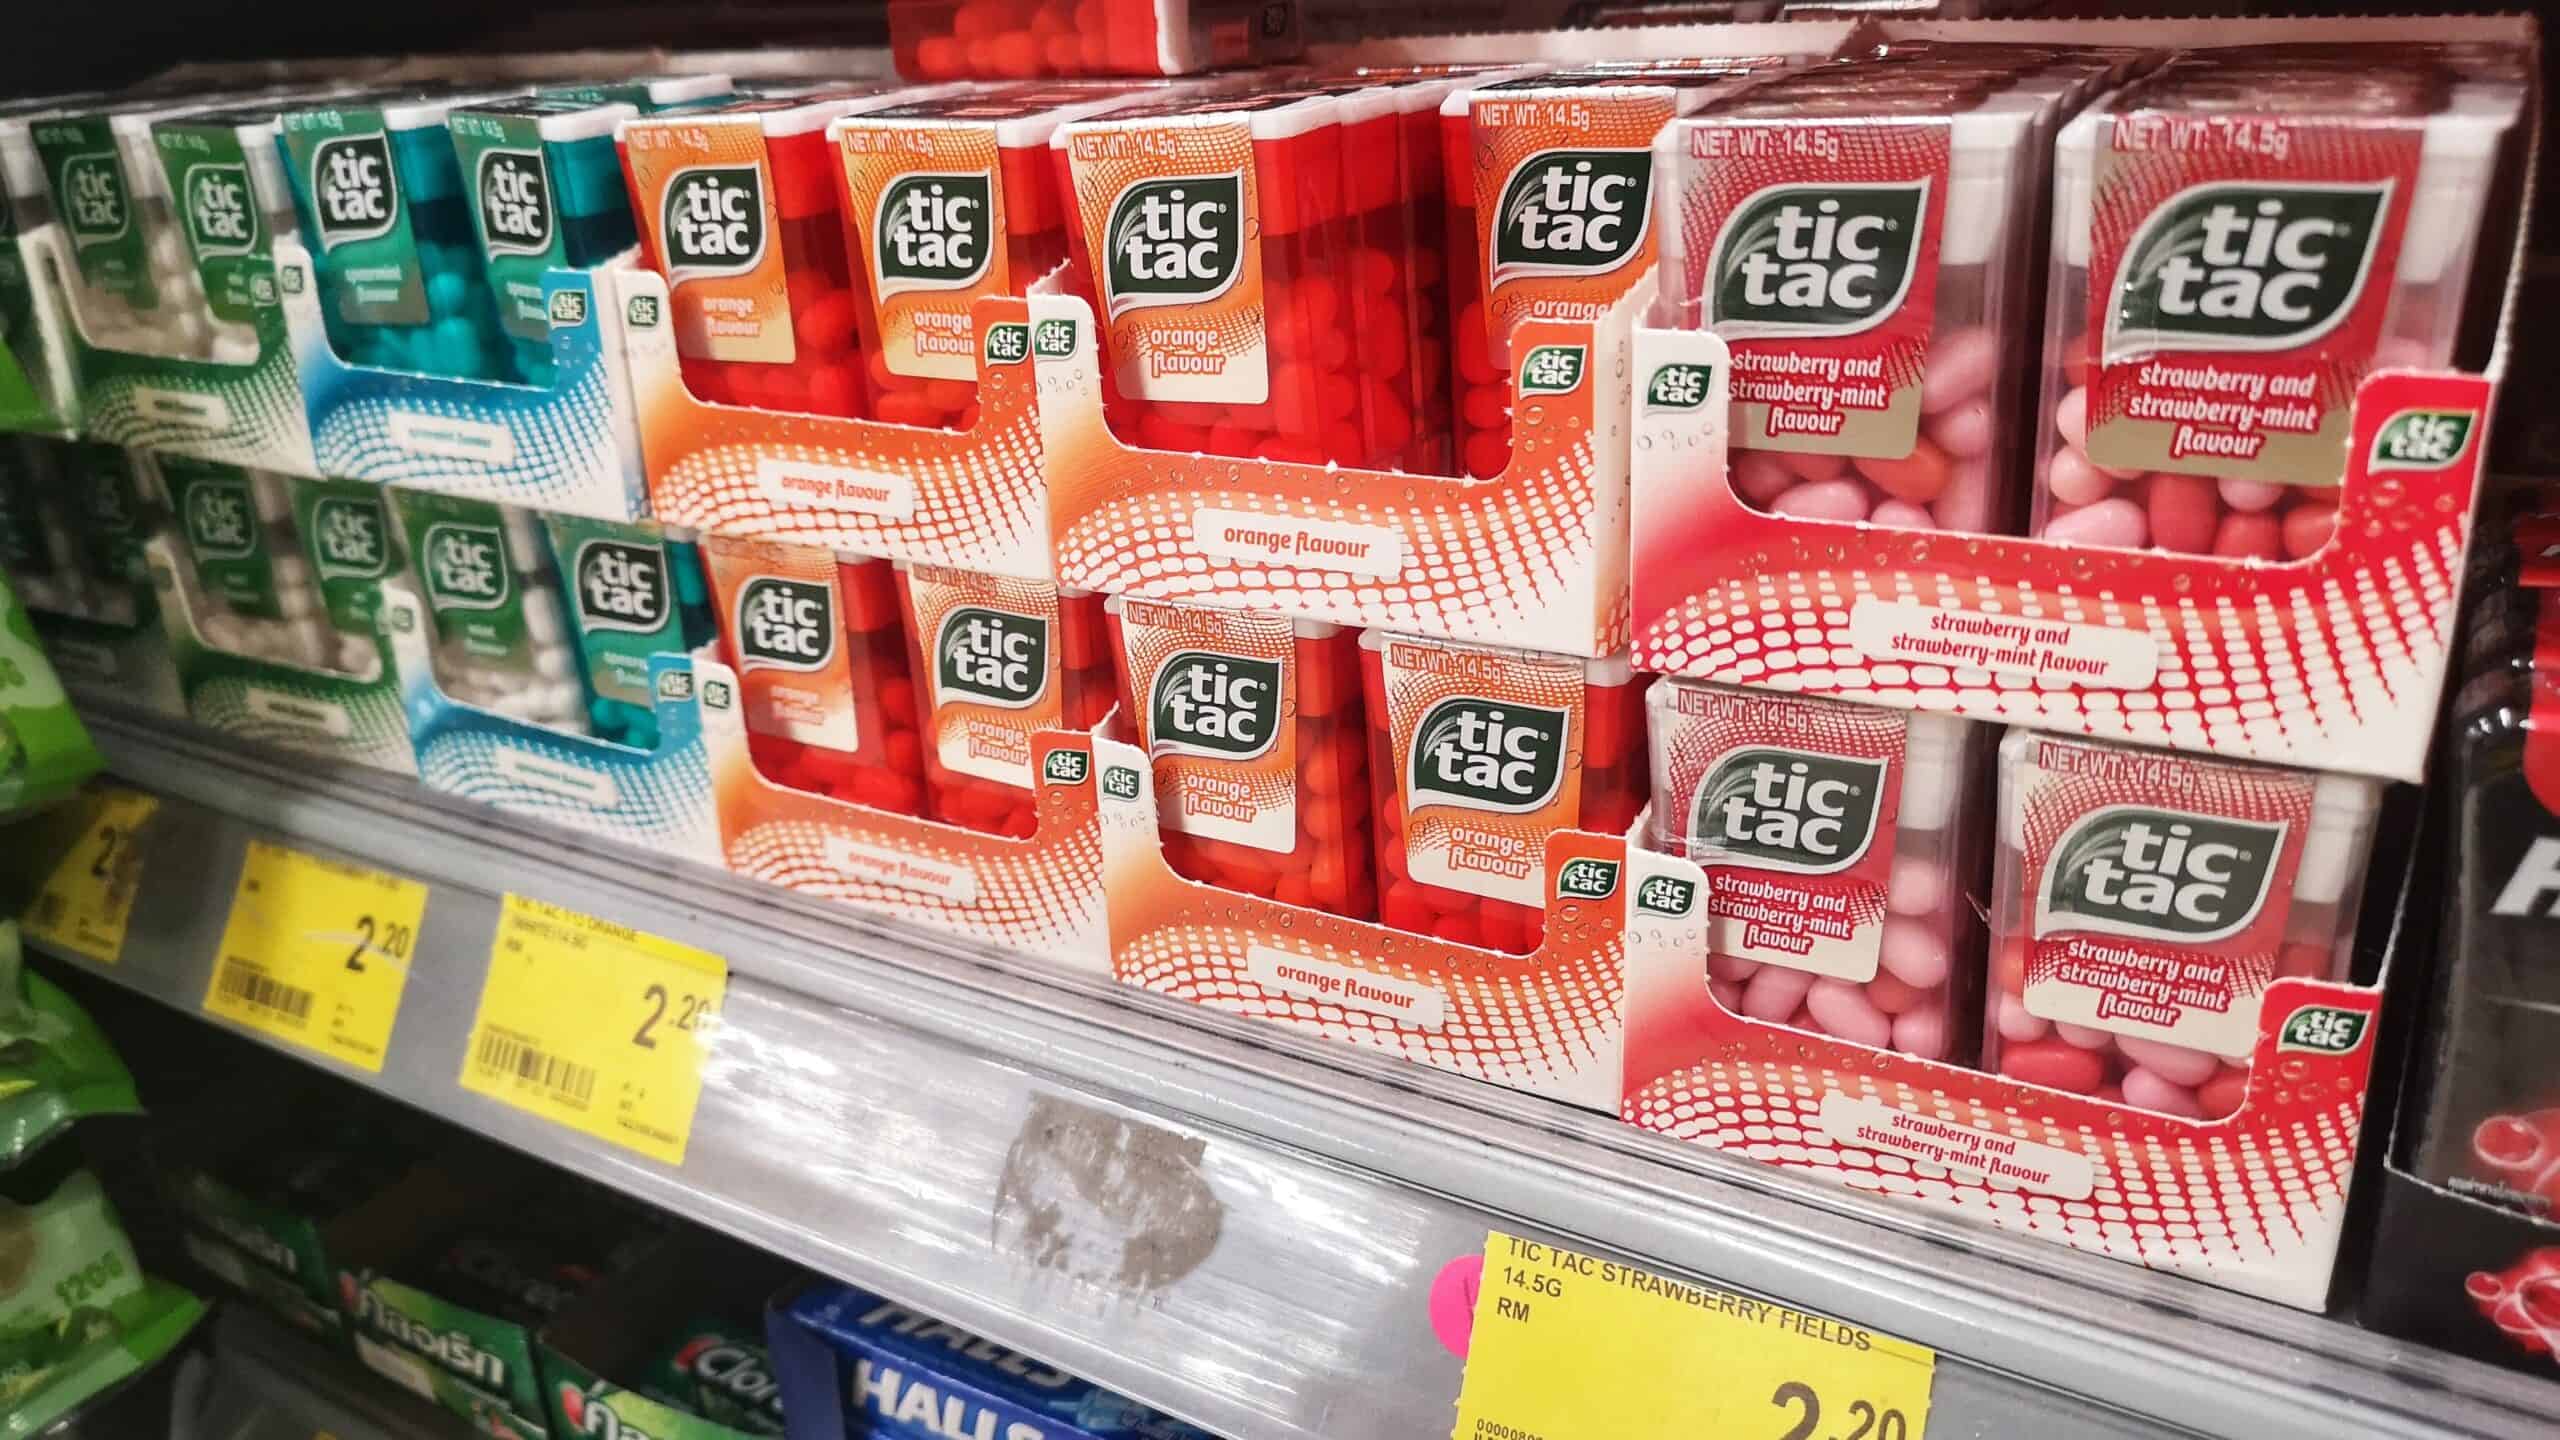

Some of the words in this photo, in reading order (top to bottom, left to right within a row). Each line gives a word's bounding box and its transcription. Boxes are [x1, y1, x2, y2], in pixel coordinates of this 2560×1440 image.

[1479, 103, 1510, 126] NET
[1546, 106, 1590, 132] 14.5g
[847, 131, 873, 153] NET
[900, 132, 935, 158] 14.5g
[1075, 135, 1104, 160] NET
[1135, 138, 1176, 160] 14.5g
[1694, 128, 1733, 156] NET
[1783, 129, 1839, 162] 14.5g
[2114, 121, 2159, 150] NET
[2224, 124, 2289, 158] 14.5g
[330, 147, 381, 188] tic
[492, 160, 539, 203] tic
[199, 174, 243, 210] tic
[326, 187, 385, 222] tac
[686, 176, 747, 222] tic
[1543, 161, 1626, 212] tic
[197, 208, 249, 239] tac
[489, 198, 543, 237] tac
[906, 185, 973, 233] tic
[1142, 189, 1219, 240] tic
[677, 218, 751, 257] tac
[1519, 206, 1621, 252] tac
[1774, 199, 1884, 261] tic
[2201, 200, 2335, 268] tic
[896, 228, 974, 268] tac
[1126, 234, 1219, 280] tac
[1742, 252, 1878, 309] tac
[2158, 255, 2321, 322] tac
[998, 327, 1024, 343] tic
[1040, 337, 1070, 352] tac
[1046, 322, 1072, 338] tic
[1150, 326, 1218, 351] orange
[992, 342, 1022, 356] tac
[1154, 351, 1226, 376] flavour
[1540, 350, 1577, 369] tic
[1734, 350, 1839, 382] strawberry
[1844, 355, 1882, 378] and
[1531, 365, 1573, 385] tac
[1664, 366, 1702, 388] tic
[2139, 364, 2262, 400] strawberry
[2269, 373, 2316, 398] and
[1654, 384, 1700, 404] tac
[1730, 380, 1886, 410] strawberry-mint
[2130, 393, 2317, 430] strawberry-mint
[1770, 407, 1841, 433] flavour
[2407, 416, 2455, 444] tic
[2175, 427, 2260, 457] flavour
[2390, 435, 2449, 461] tac
[1223, 525, 1292, 553] orange
[1295, 529, 1371, 559] flavour
[600, 551, 653, 590] tic
[590, 582, 655, 618] tac
[762, 587, 819, 626] tic
[753, 619, 820, 657] tac
[1128, 602, 1154, 624] NET
[1185, 611, 1222, 638] 14.5g
[1931, 613, 2030, 646] strawberry
[2035, 627, 2071, 646] and
[967, 618, 1029, 663] tic
[1892, 633, 2036, 667] strawberry-mint
[2039, 646, 2109, 676] flavour
[954, 648, 1029, 693] tac
[1393, 645, 1422, 668] NET
[1459, 656, 1501, 685] 14.5g
[1192, 663, 1260, 711] tic
[1171, 697, 1257, 743] tac
[1678, 692, 1717, 715] NET
[1756, 701, 1808, 733] 14.5g
[969, 720, 1024, 745] orange
[1459, 711, 1540, 760] tic
[969, 737, 1028, 765] flavour
[1056, 752, 1081, 767] tic
[1435, 742, 1536, 795] tac
[1052, 763, 1081, 778] tac
[1108, 779, 1134, 796] tac
[1113, 769, 1136, 785] tic
[1187, 772, 1251, 801] orange
[2040, 746, 2084, 772] NET
[2132, 761, 2195, 794] 14.5g
[1751, 761, 1851, 817] tic
[1186, 793, 1257, 822] flavour
[1451, 826, 1526, 857] orange
[1723, 796, 1842, 856] tac
[1449, 847, 1531, 878] flavour
[2121, 822, 2239, 883] tic
[1568, 877, 1605, 892] tac
[1577, 863, 1609, 880] tic
[1654, 880, 1686, 899] tic
[2083, 857, 2227, 922] tac
[1645, 893, 1684, 912] tac
[1715, 875, 1810, 908] strawberry
[1813, 891, 1846, 912] and
[1709, 897, 1852, 938] strawberry-mint
[345, 915, 410, 974] 2.20
[1748, 924, 1812, 953] flavour
[2069, 939, 2179, 980] strawberry
[2184, 960, 2225, 983] and
[1276, 962, 1342, 993] orange
[1344, 977, 1416, 1010] flavour
[2061, 962, 2228, 1010] strawberry-mint
[2101, 994, 2179, 1025] flavour
[2310, 1011, 2354, 1037] tic
[2295, 1024, 2350, 1049] tac
[1892, 1113, 1981, 1150] strawberry
[1984, 1138, 2016, 1156] and
[1857, 1124, 1987, 1169] strawberry-mint
[1989, 1157, 2051, 1185] flavour
[1502, 1266, 1562, 1299] 14.5G
[1506, 1236, 1542, 1263] TIC
[1547, 1248, 1594, 1278] TAC
[1601, 1262, 1772, 1325] STRAWBERRY
[1779, 1309, 1872, 1352] FIELDS
[1496, 1297, 1531, 1324] RM
[1771, 1381, 1907, 1440] 2.20
